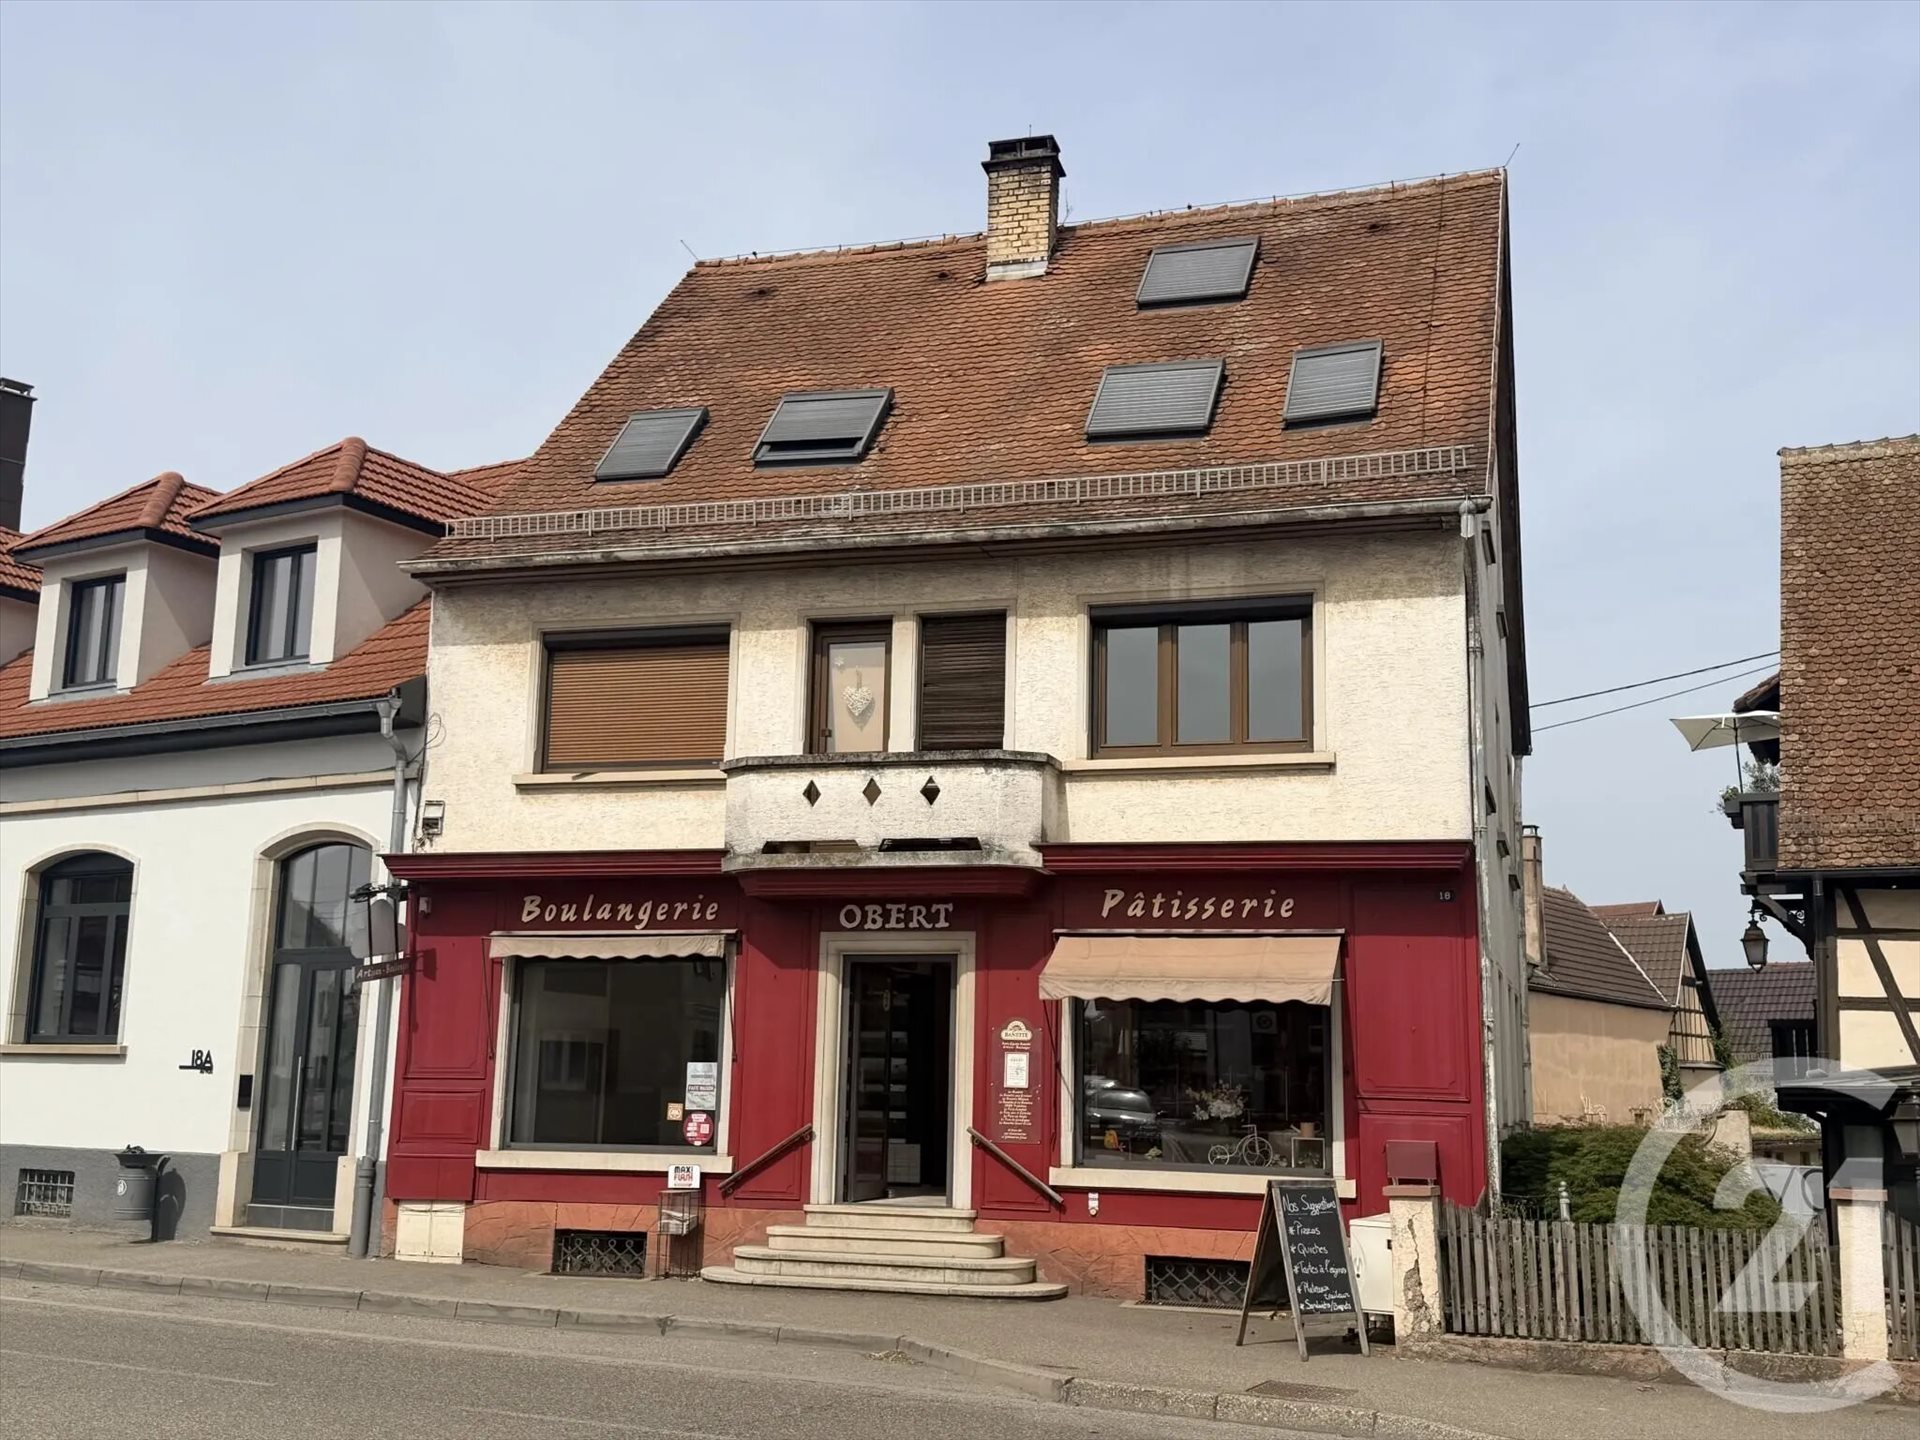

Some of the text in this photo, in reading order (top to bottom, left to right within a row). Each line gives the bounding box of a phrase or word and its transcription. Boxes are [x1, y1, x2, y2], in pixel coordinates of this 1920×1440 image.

[1101, 889, 1295, 920] Pâtisserie
[1439, 891, 1451, 900] 18
[521, 894, 719, 930] Boulangerie
[840, 903, 953, 929] OBERT
[191, 1049, 213, 1067] 18A
[1282, 1194, 1299, 1212] Nos
